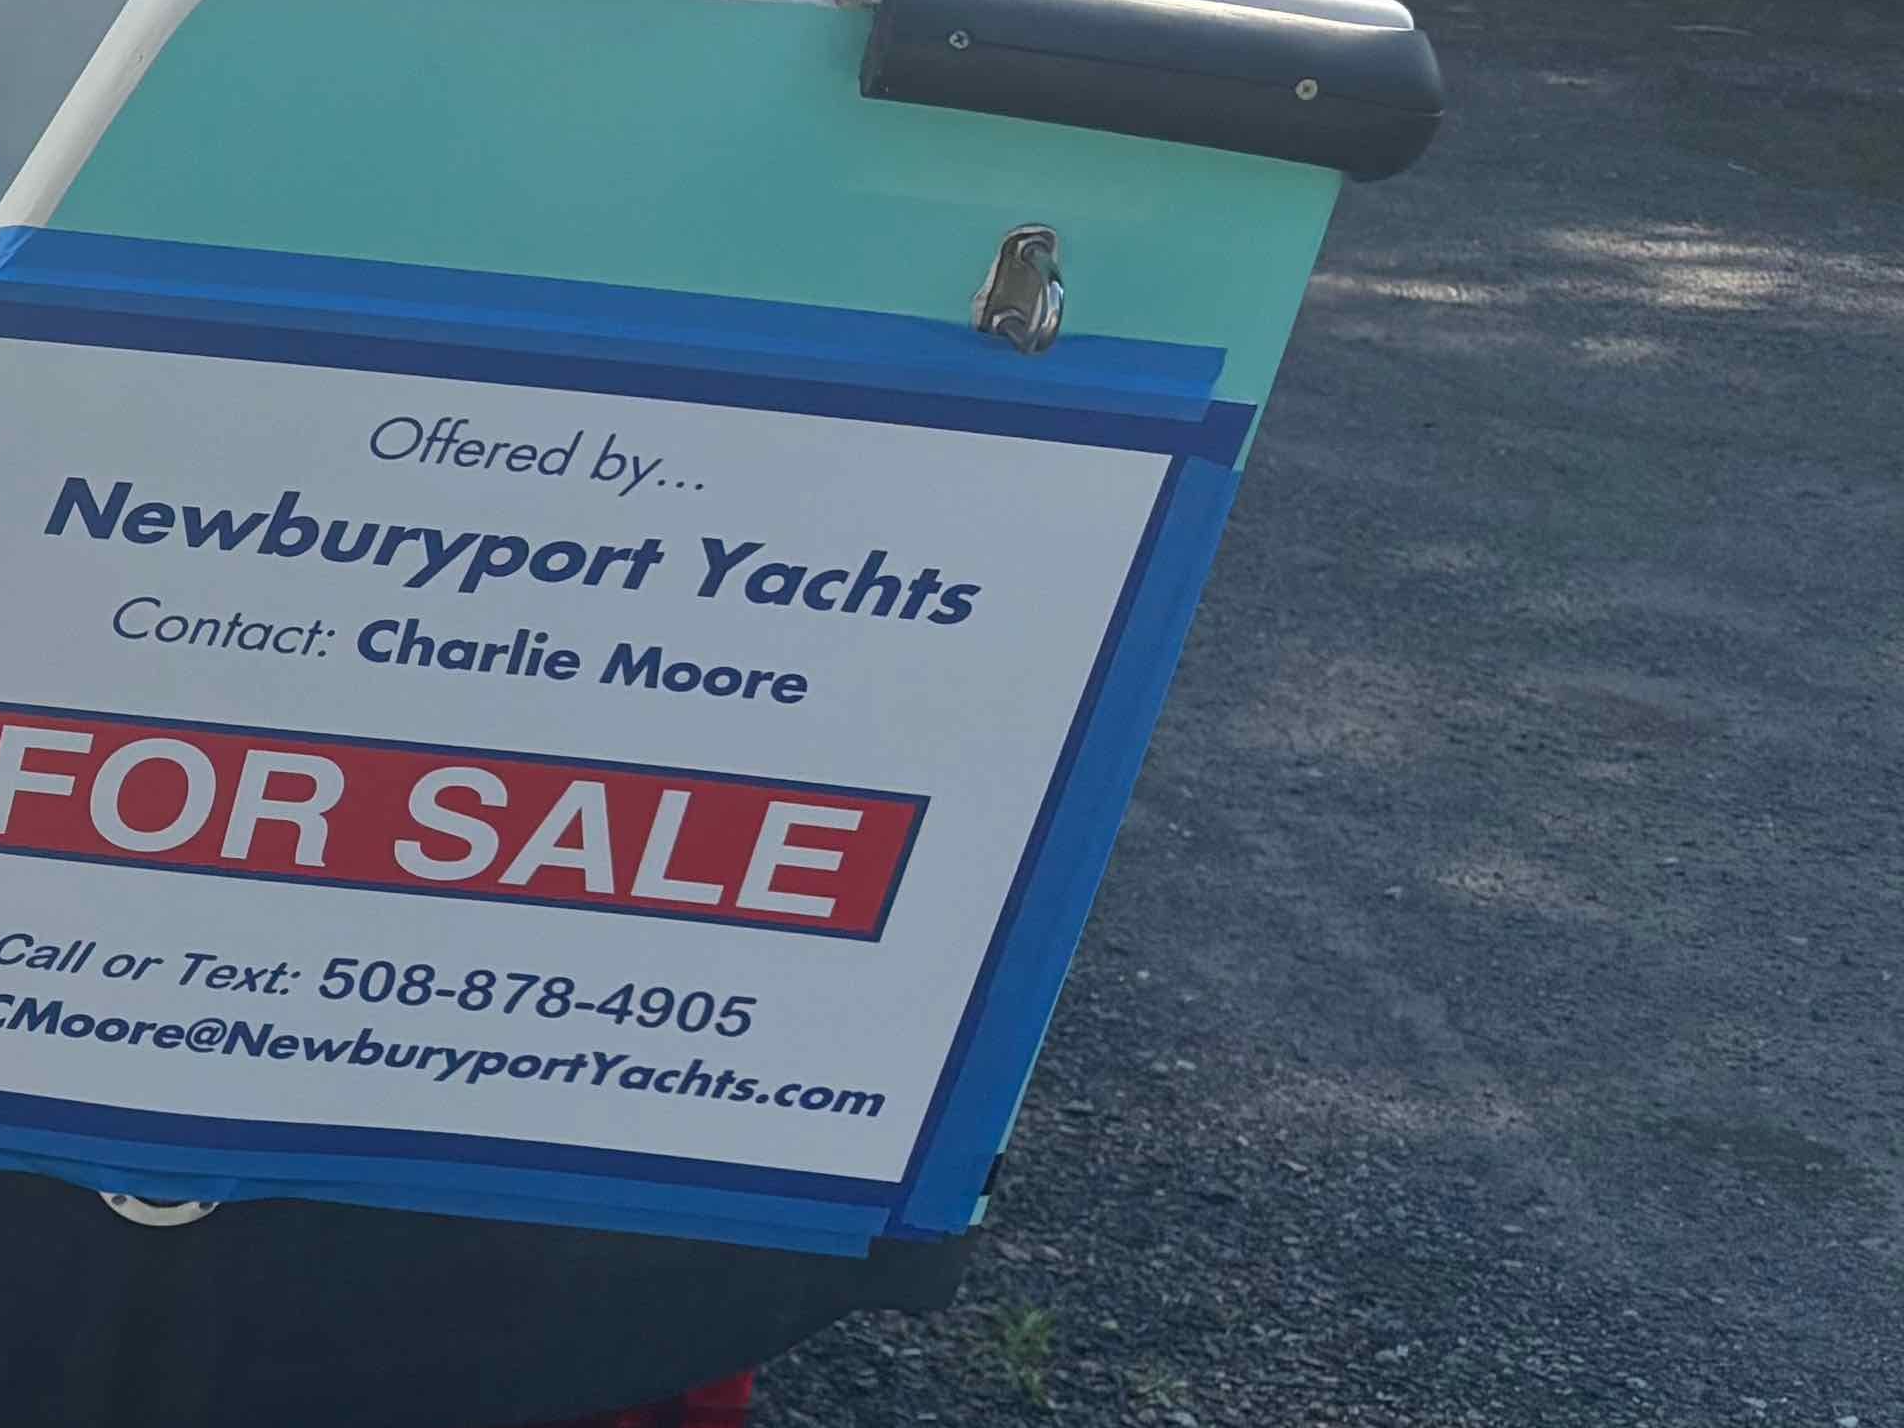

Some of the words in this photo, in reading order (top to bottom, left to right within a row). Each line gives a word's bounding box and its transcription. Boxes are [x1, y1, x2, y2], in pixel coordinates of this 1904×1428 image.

[370, 417, 584, 477] Offered
[590, 434, 704, 497] by...
[44, 477, 664, 594] Newburyport
[697, 537, 982, 625] Yachts
[113, 597, 336, 658] Contact:
[357, 619, 581, 680] Charlie
[600, 643, 808, 705] Moore
[394, 766, 863, 918] SALE
[103, 954, 165, 981] or
[179, 953, 301, 995] Text:
[319, 958, 758, 1038] 508-878-4905
